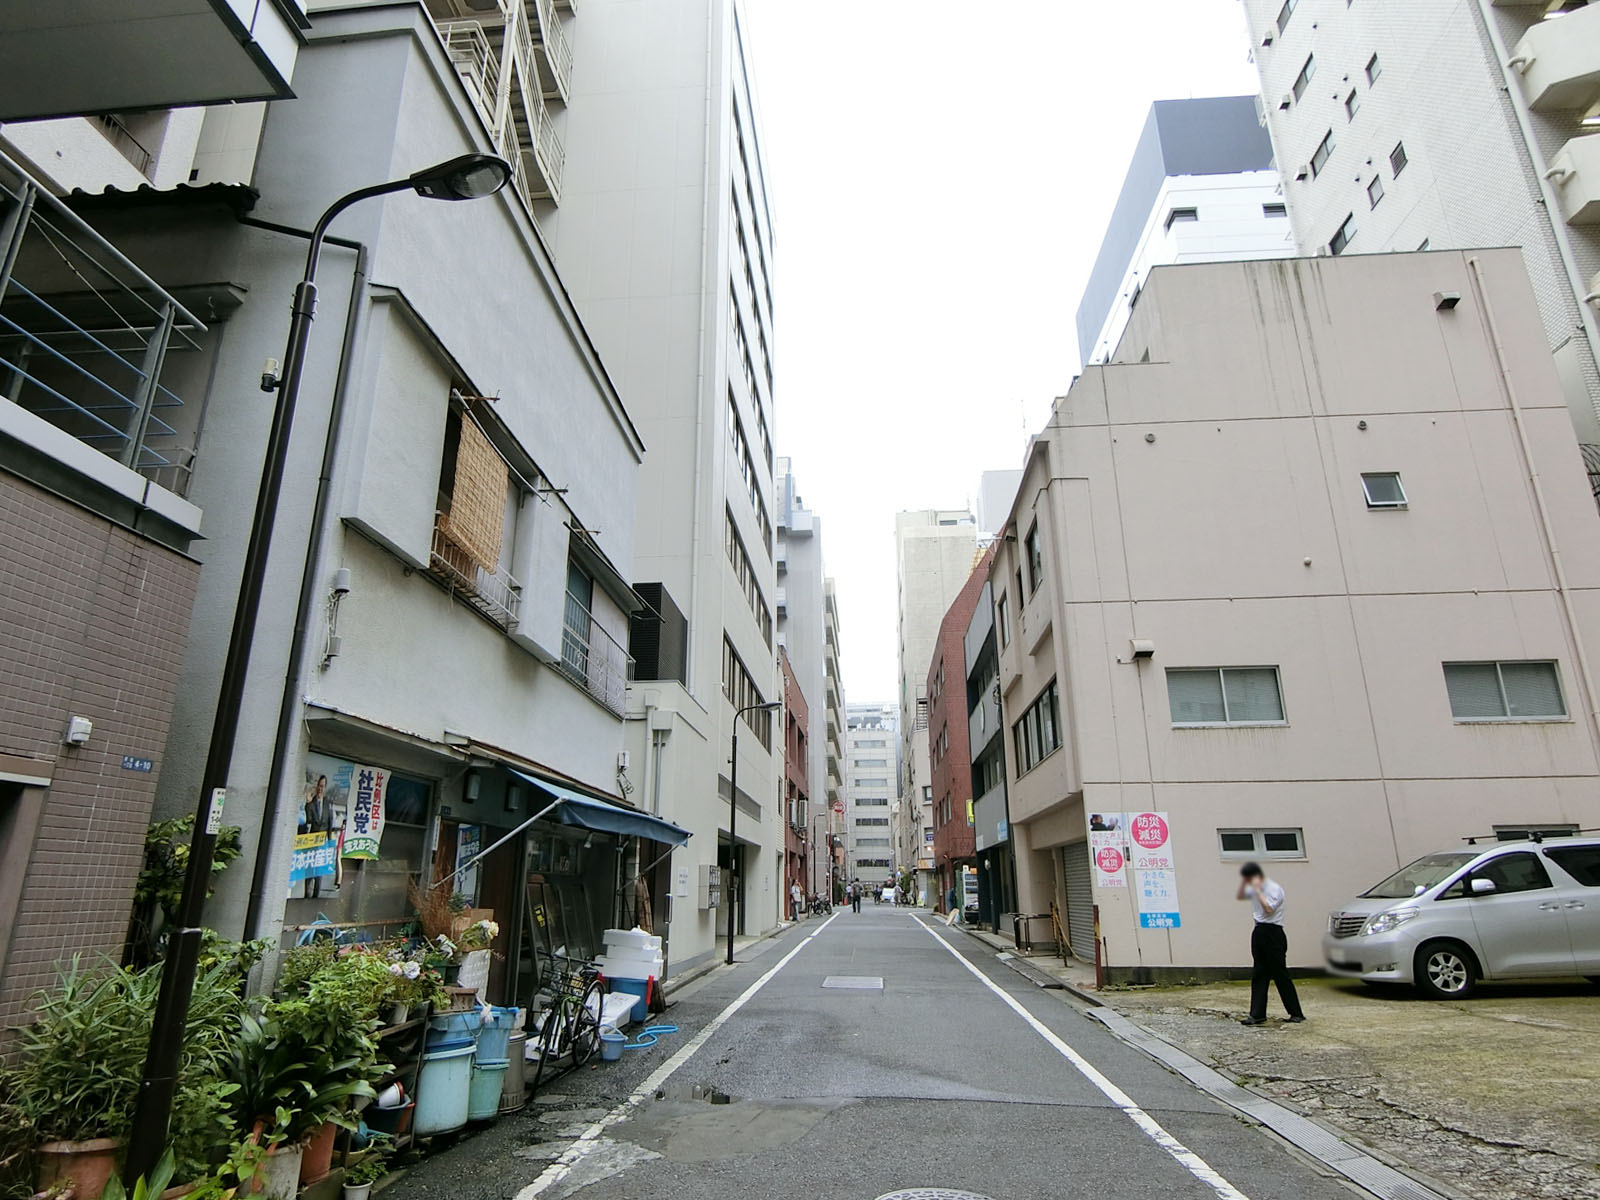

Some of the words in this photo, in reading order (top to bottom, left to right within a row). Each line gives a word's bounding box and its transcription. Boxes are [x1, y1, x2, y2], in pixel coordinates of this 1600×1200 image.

[134, 760, 151, 770] 4-10
[354, 769, 374, 833] 社民党
[371, 772, 383, 830] 比例区は
[1137, 816, 1160, 828] 防災
[1138, 829, 1162, 841] 減災
[1100, 849, 1117, 858] 防災
[1101, 858, 1118, 867] 減災
[1139, 858, 1169, 868] 公明党
[1147, 918, 1174, 928] 公明党
